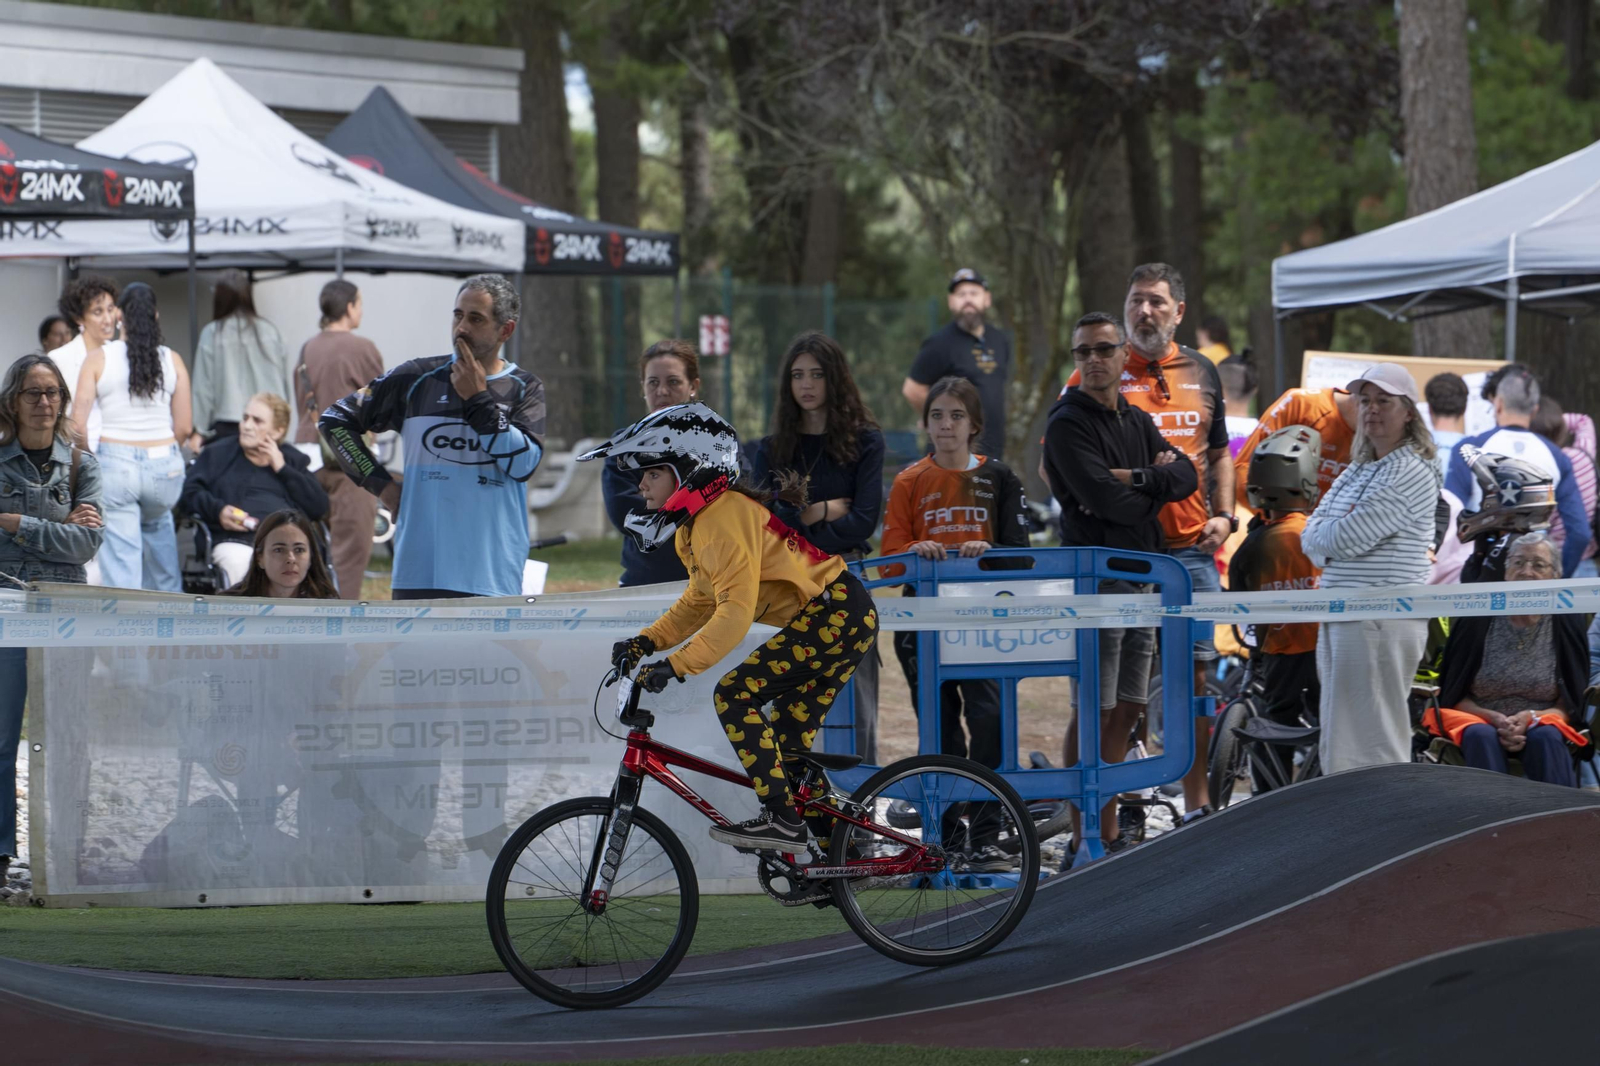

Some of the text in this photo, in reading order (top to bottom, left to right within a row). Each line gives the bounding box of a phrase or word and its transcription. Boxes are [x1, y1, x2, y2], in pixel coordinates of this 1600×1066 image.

[20, 172, 85, 201] 24MX
[124, 177, 183, 209] 24MX
[553, 233, 602, 261] 24MX
[625, 237, 672, 265] 24MX
[1291, 603, 1327, 612] XUNTA
[1347, 603, 1388, 611] DEPORTE
[1453, 601, 1487, 610] XUNTA
[1508, 600, 1550, 609] DEPORTE
